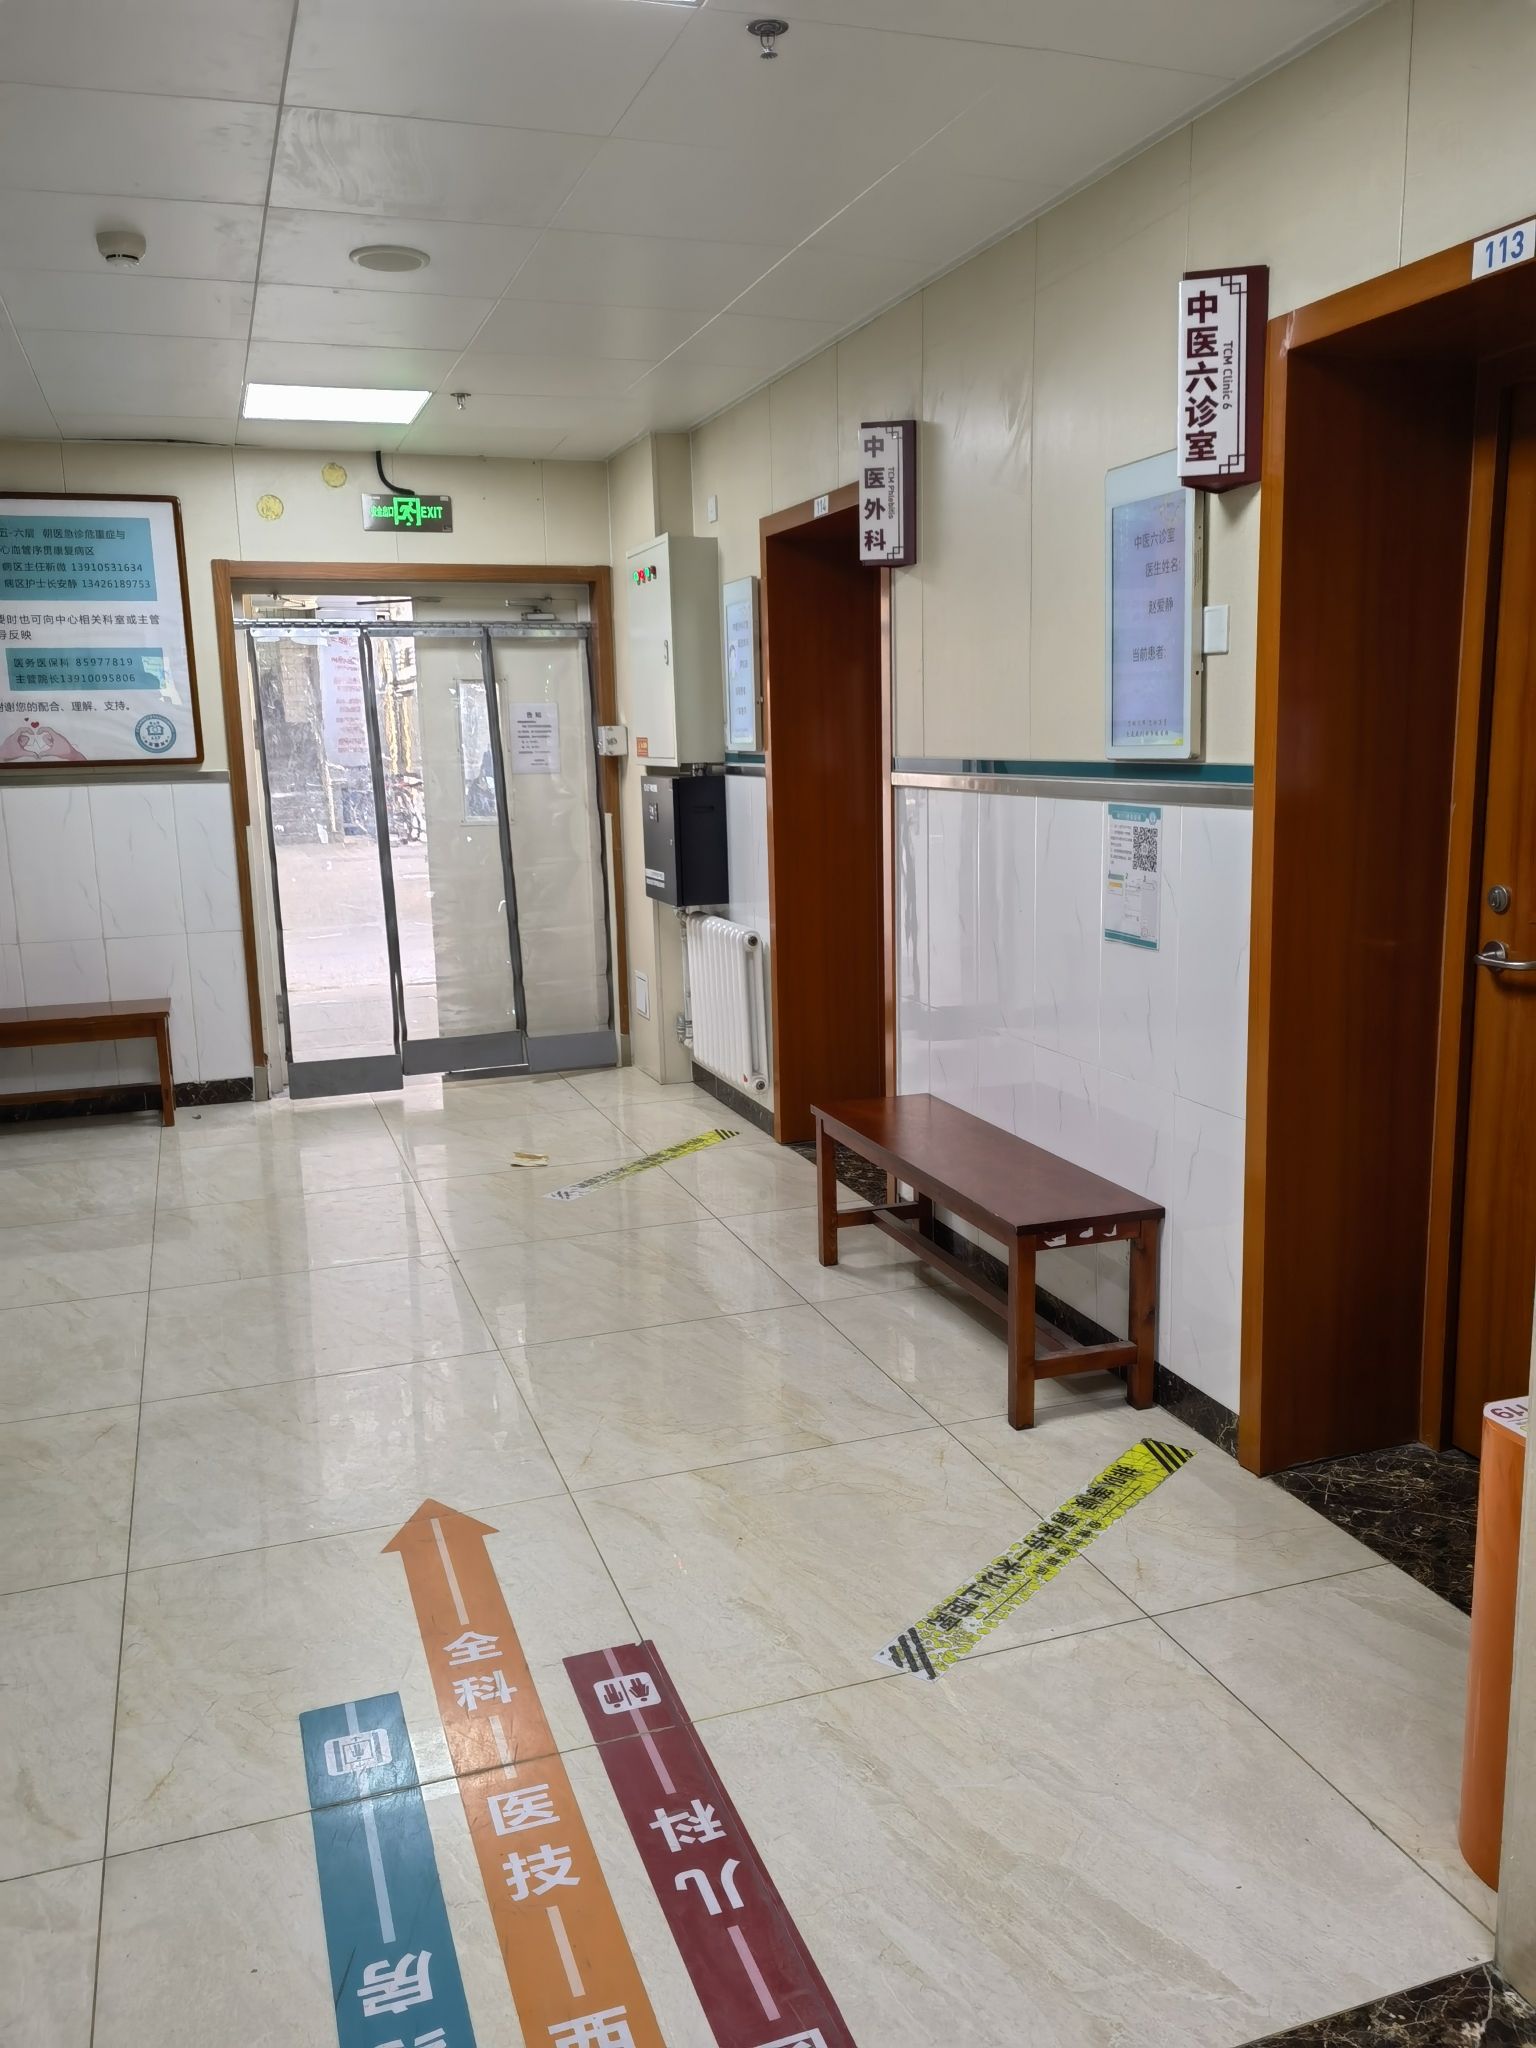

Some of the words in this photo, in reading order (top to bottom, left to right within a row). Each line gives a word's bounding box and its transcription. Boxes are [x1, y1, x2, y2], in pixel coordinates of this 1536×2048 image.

[1485, 230, 1524, 269] 113
[1223, 340, 1234, 365] TCM
[1184, 290, 1219, 463] 中医六诊室
[1222, 368, 1233, 400] Clinic
[1222, 402, 1233, 410] 6
[863, 434, 886, 552] 中医外科
[421, 506, 443, 519] EXIT
[1134, 528, 1176, 551] 中医六诊室
[71, 562, 143, 572] 13910531634
[82, 579, 152, 589] 13426189753
[75, 657, 133, 667] 85977819
[443, 1631, 518, 1711] 全科
[487, 1783, 581, 1902] 医技
[649, 1799, 745, 1916] 儿科
